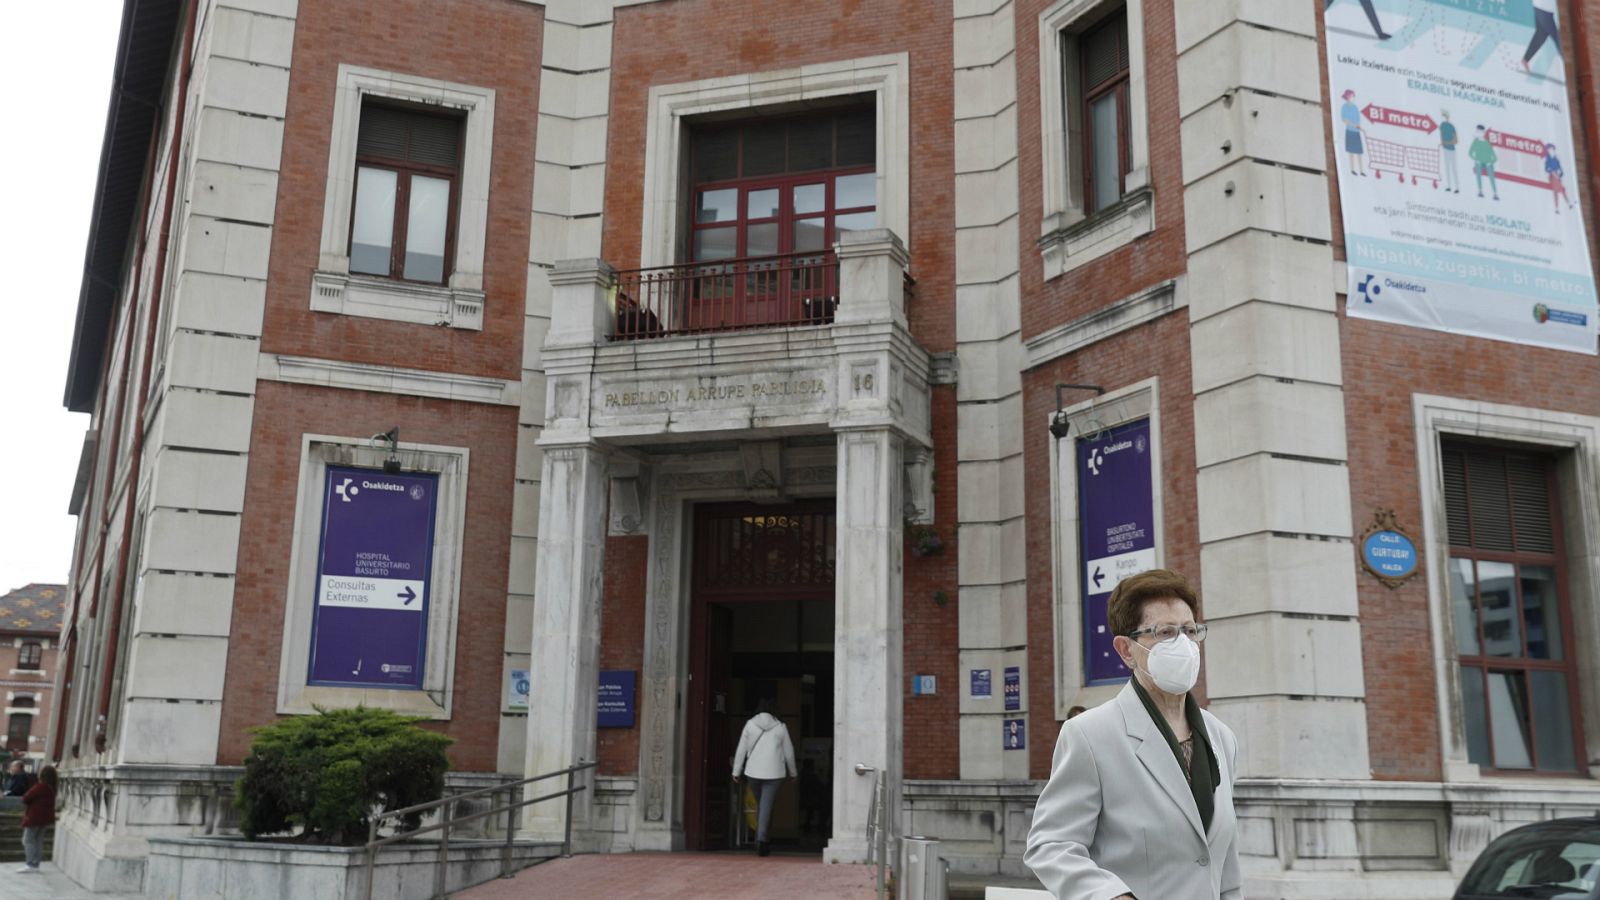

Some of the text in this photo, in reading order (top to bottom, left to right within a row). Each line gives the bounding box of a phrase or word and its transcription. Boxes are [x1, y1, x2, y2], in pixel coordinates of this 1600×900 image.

[1407, 79, 1505, 109] ERABILI MASKARA
[1369, 107, 1431, 129] Bi metro
[1488, 131, 1543, 154] Bi metro
[1485, 214, 1531, 233] ISOLATU
[1356, 242, 1430, 272] Nigatik,
[1435, 258, 1507, 283] zugatik,
[1511, 269, 1530, 285] bi
[1384, 278, 1427, 293] Osakidetza
[853, 373, 874, 391] 16
[604, 389, 681, 407] PABELLON
[686, 384, 745, 401] ARRUPE
[1103, 440, 1133, 455] Osakidetza
[362, 480, 405, 492] Osakidetza
[1106, 522, 1137, 537] BASURTOKO
[1107, 540, 1134, 553] OSPITALEA
[1379, 534, 1400, 544] CALLE
[356, 552, 391, 561] HOSPITAL
[1116, 558, 1137, 570] Kanpo
[355, 560, 411, 570] UNIVERSITARIO
[355, 567, 389, 576] BASURTO
[327, 578, 376, 592] Consultas
[326, 591, 369, 603] Externas
